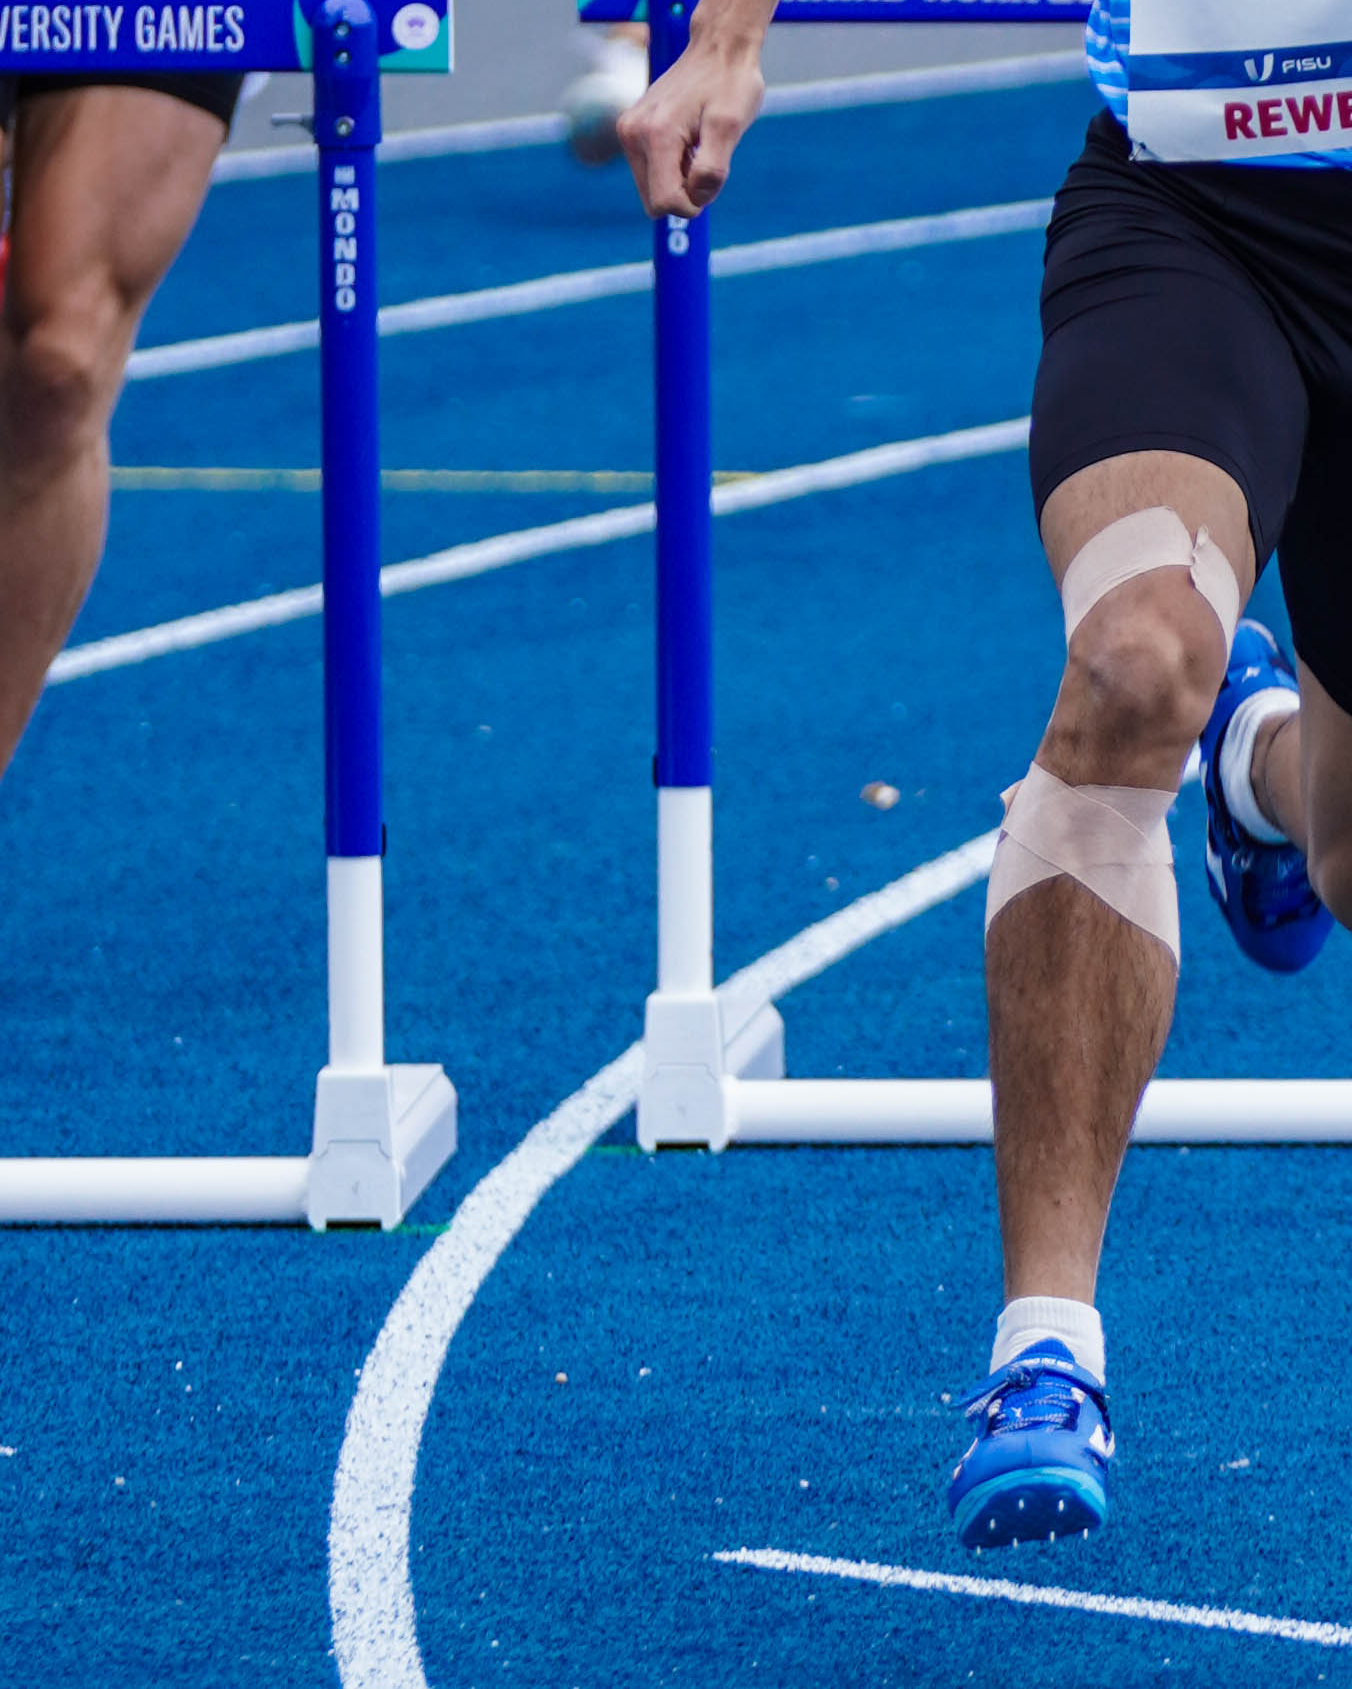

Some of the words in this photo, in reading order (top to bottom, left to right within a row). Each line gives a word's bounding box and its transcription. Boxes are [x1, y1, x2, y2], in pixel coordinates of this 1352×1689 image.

[134, 5, 245, 52] GAMES
[1282, 55, 1332, 74] FISU
[330, 187, 359, 312] MONDO
